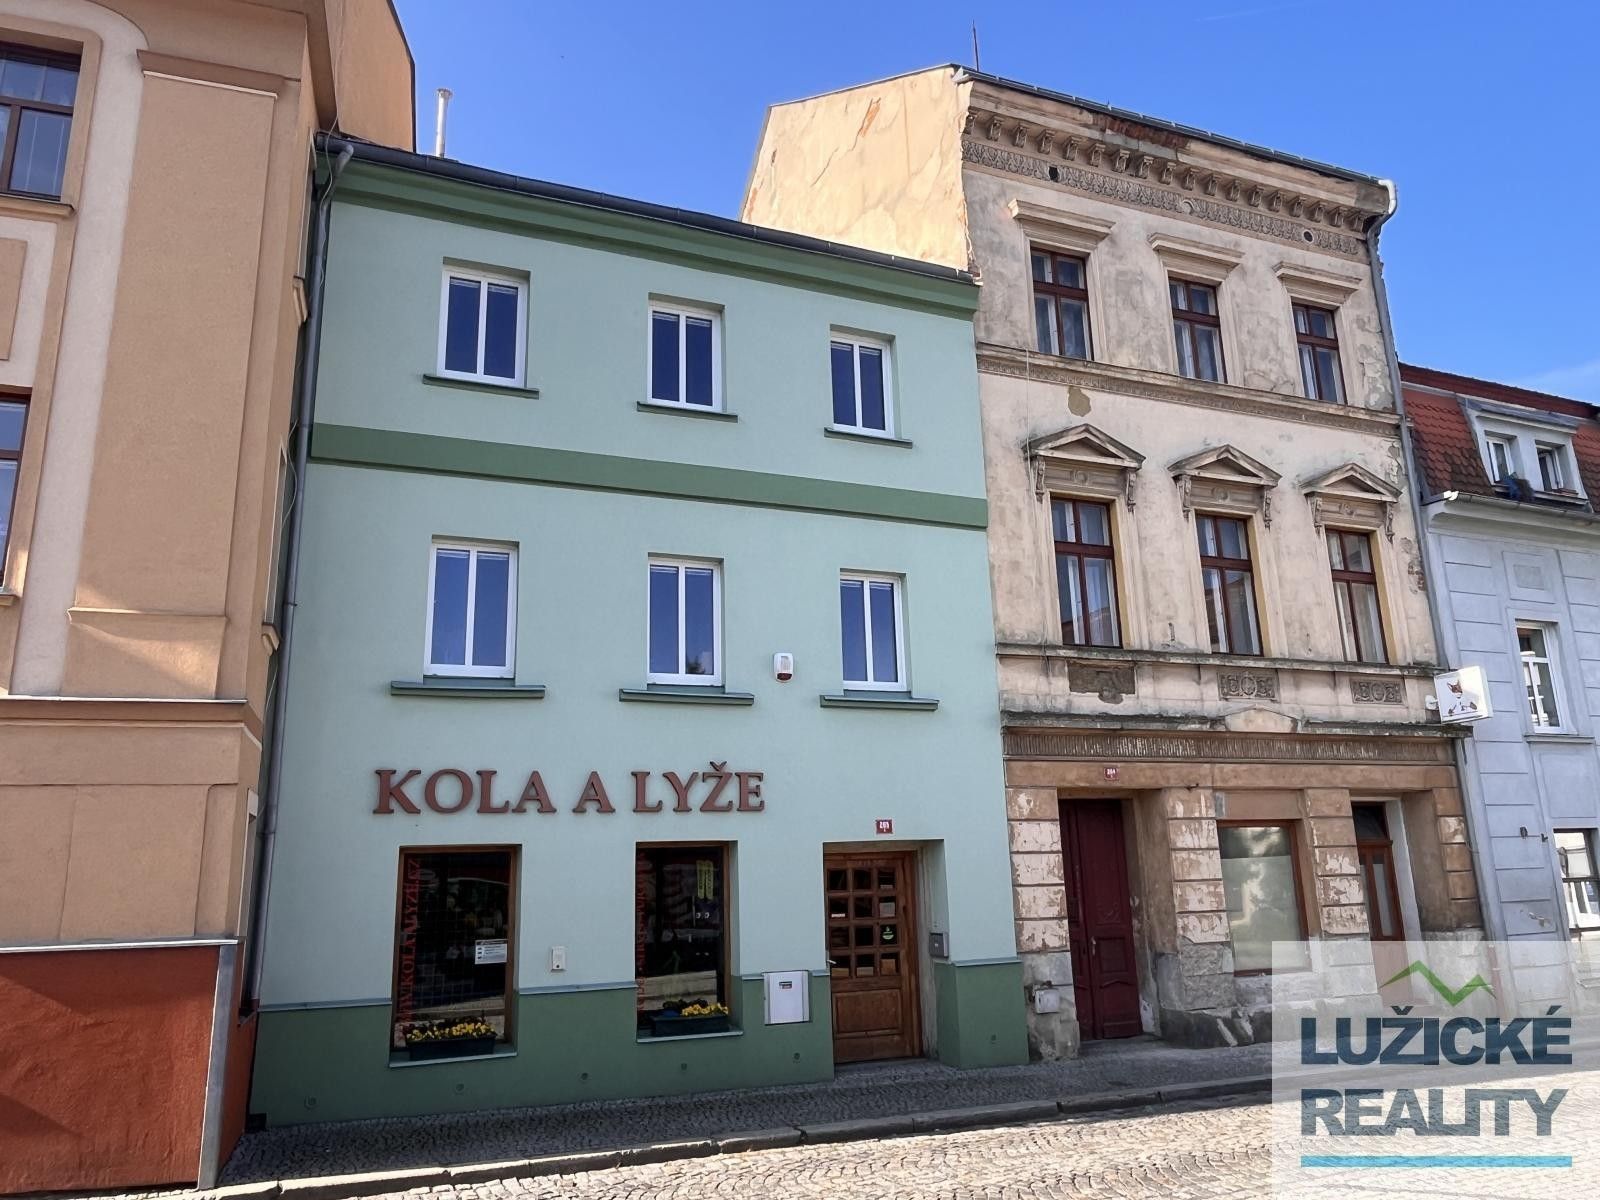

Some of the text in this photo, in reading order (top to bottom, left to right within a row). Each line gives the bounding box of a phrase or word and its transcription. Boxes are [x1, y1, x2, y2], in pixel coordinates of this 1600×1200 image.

[373, 761, 765, 814] KOLA A LYŽE
